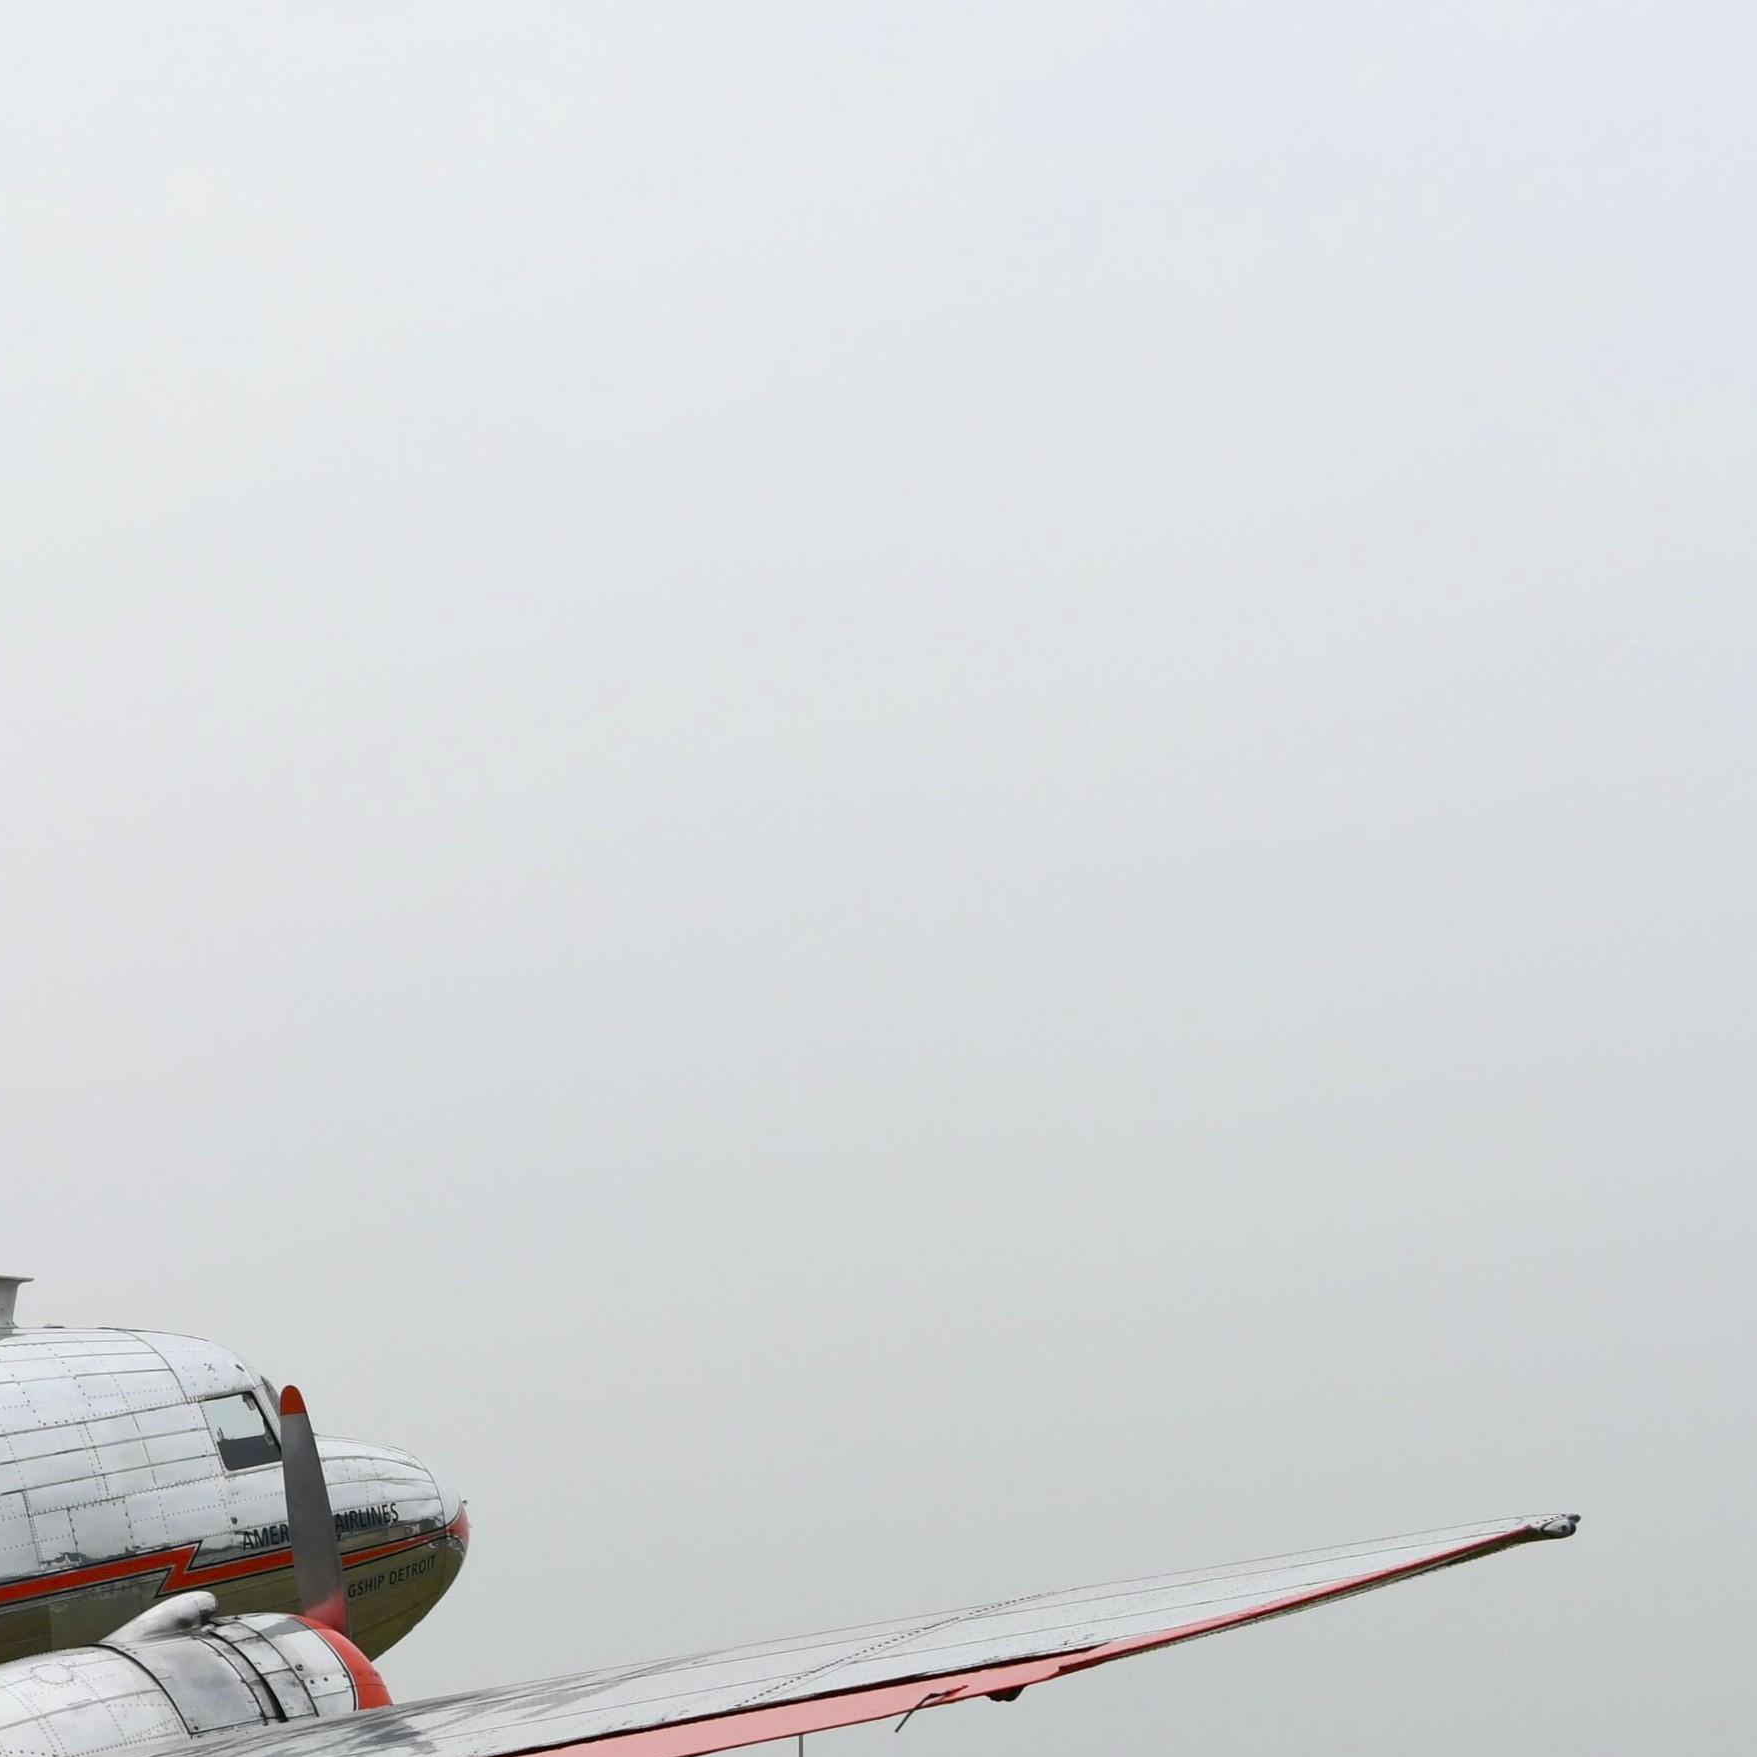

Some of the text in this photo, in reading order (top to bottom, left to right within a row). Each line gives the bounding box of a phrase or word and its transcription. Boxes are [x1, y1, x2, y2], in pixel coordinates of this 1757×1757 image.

[334, 1502, 399, 1535] AIRLINES
[347, 1554, 437, 1599] GSHIP DETROIT
